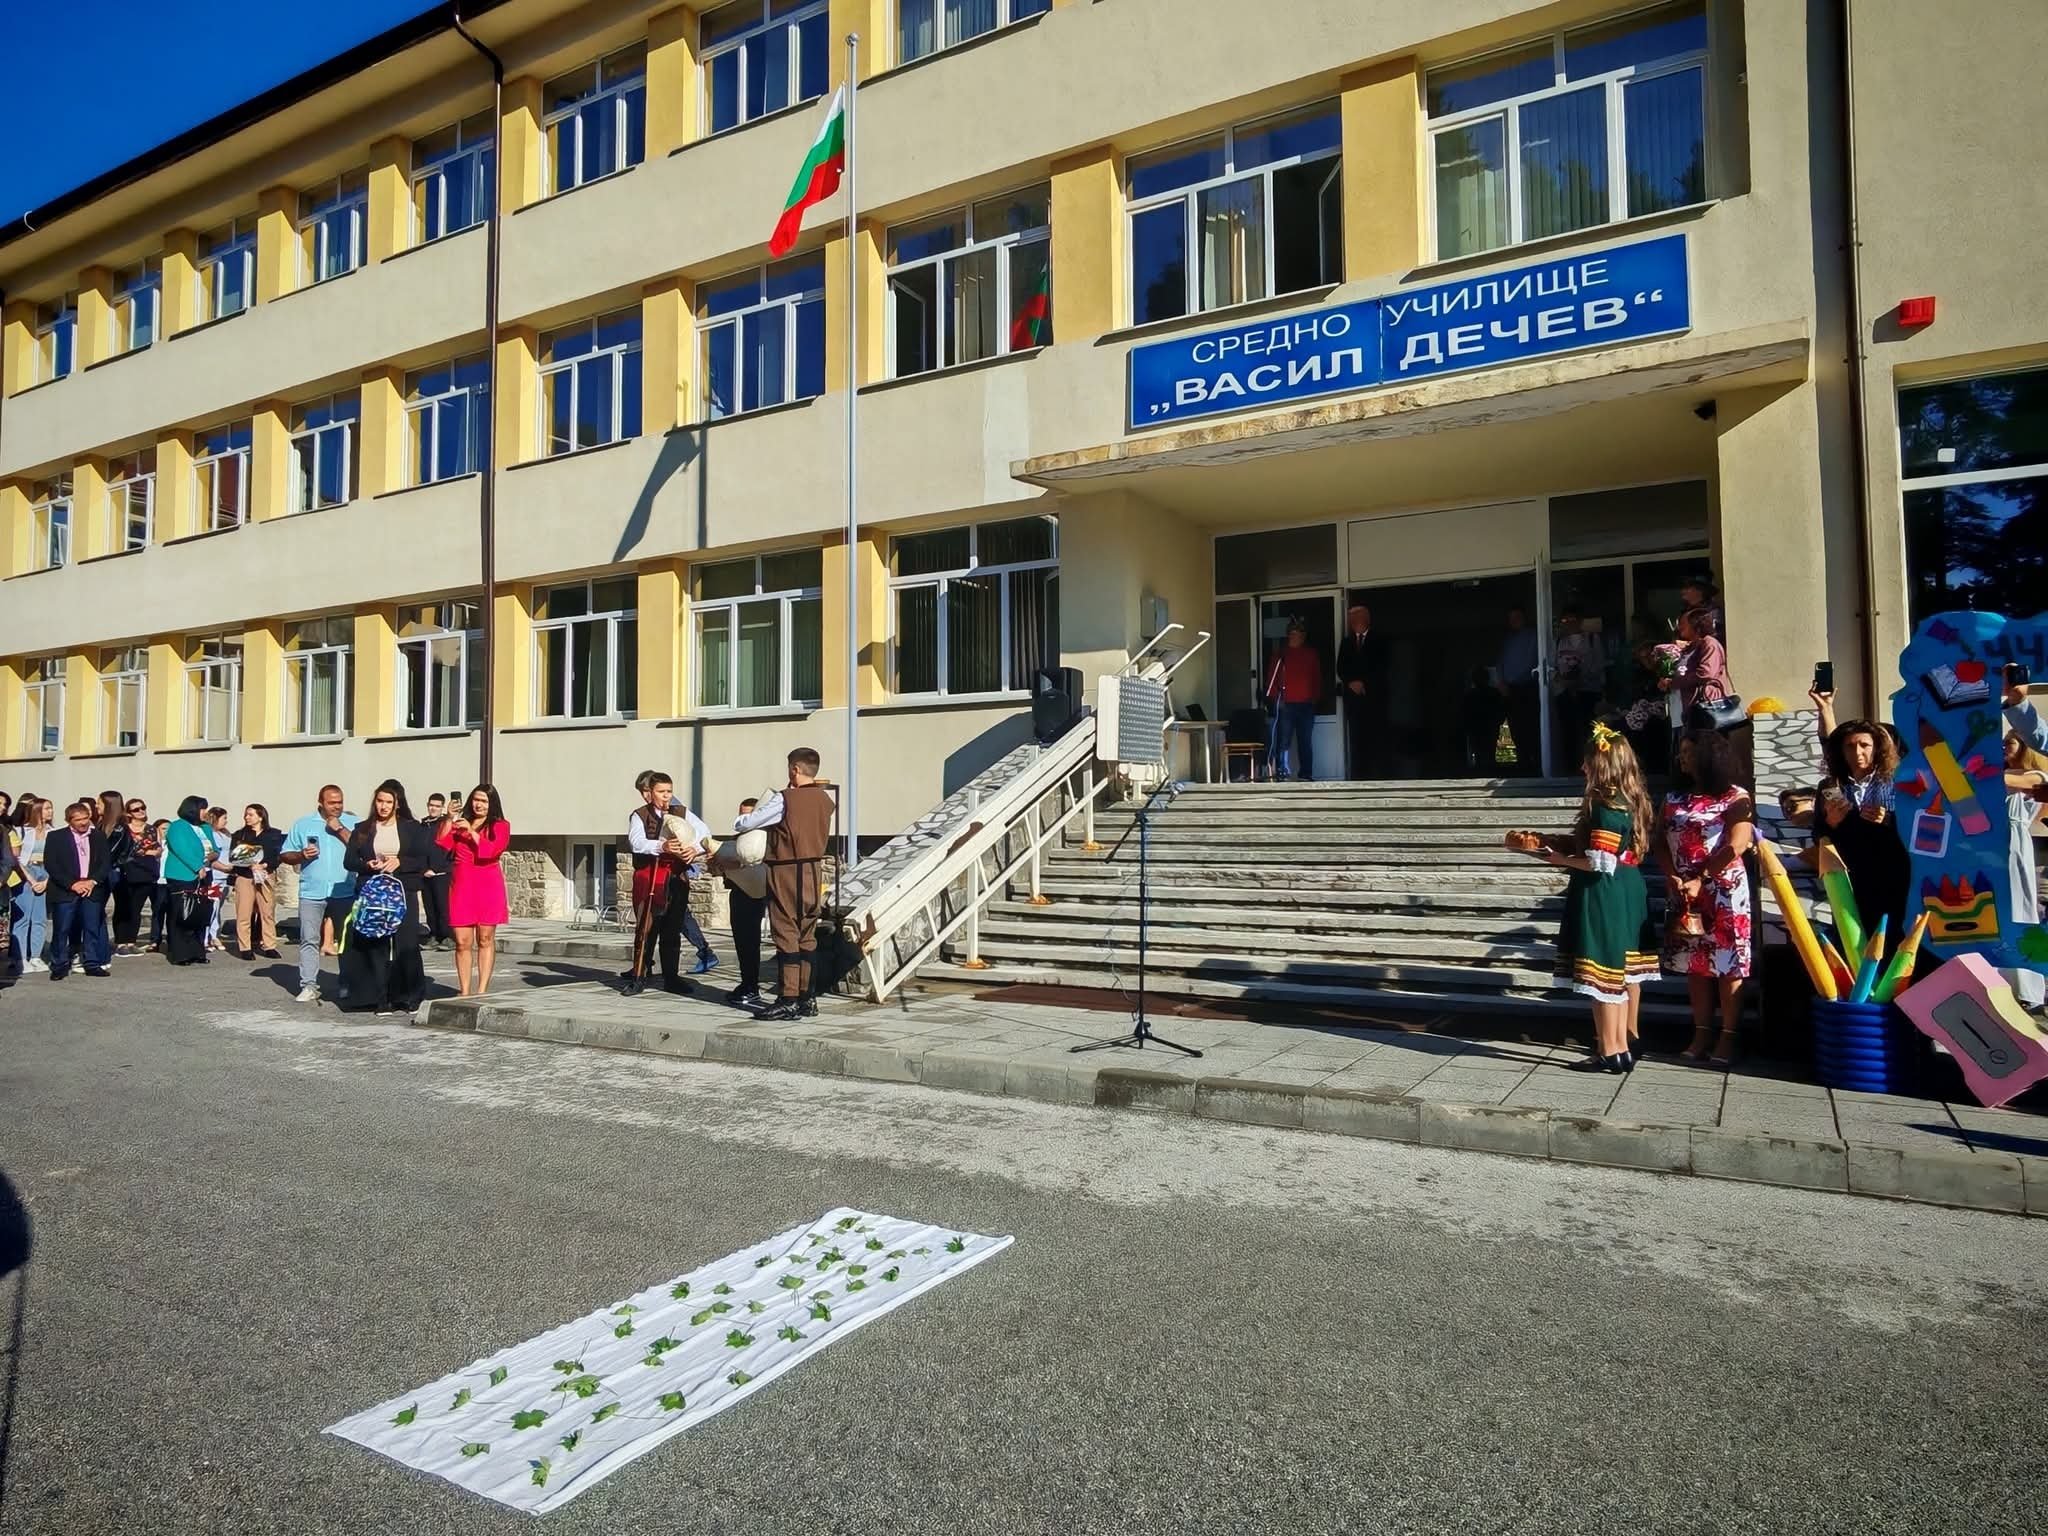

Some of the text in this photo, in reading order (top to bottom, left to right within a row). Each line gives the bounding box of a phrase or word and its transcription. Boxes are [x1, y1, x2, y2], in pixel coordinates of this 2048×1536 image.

[1192, 259, 1609, 363] СРЕДНО УЧИЛИЩЕ
[1150, 347, 1363, 416] „ВАСИЛ
